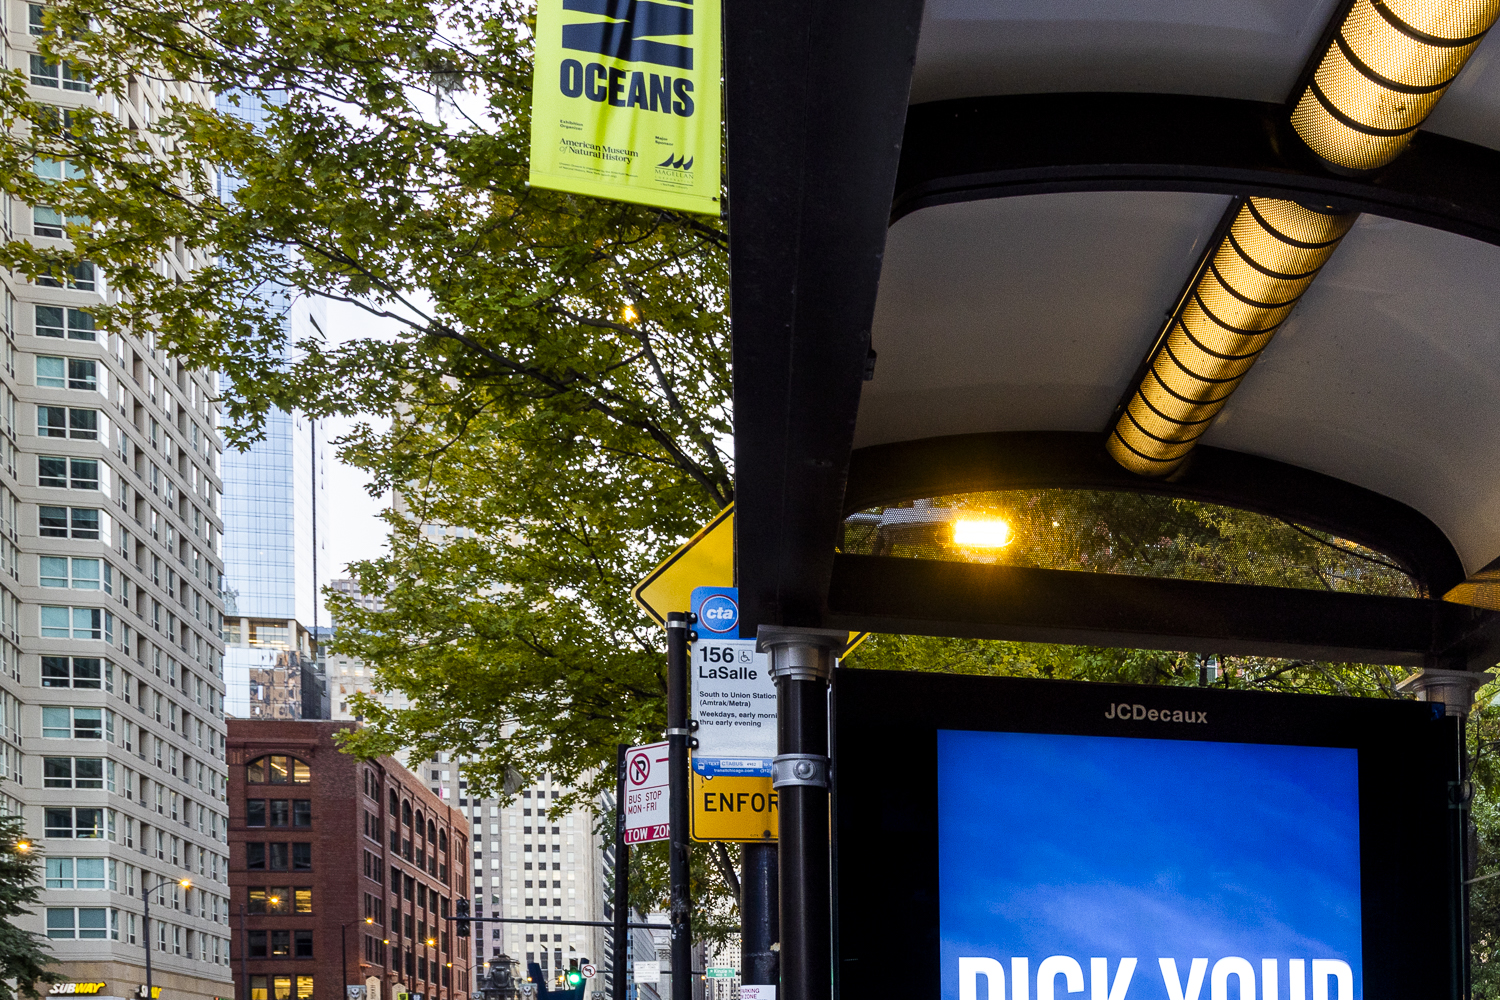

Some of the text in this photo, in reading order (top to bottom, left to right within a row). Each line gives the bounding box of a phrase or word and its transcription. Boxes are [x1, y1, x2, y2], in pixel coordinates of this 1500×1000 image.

[560, 58, 694, 117] OCEANS
[560, 138, 638, 157] American Museum
[569, 146, 600, 158] Natural
[602, 153, 632, 164] History
[655, 169, 694, 179] MAGELLAN
[706, 607, 733, 620] cta
[700, 646, 734, 663] 156
[699, 666, 758, 680] LaSalle
[1104, 702, 1208, 724] JCDecaux
[629, 790, 662, 803] BUS STOP
[704, 793, 778, 812] ENFOR
[628, 802, 656, 814] MON-FRI
[628, 825, 670, 842] TOW ZON
[50, 982, 106, 994] SUBWAY
